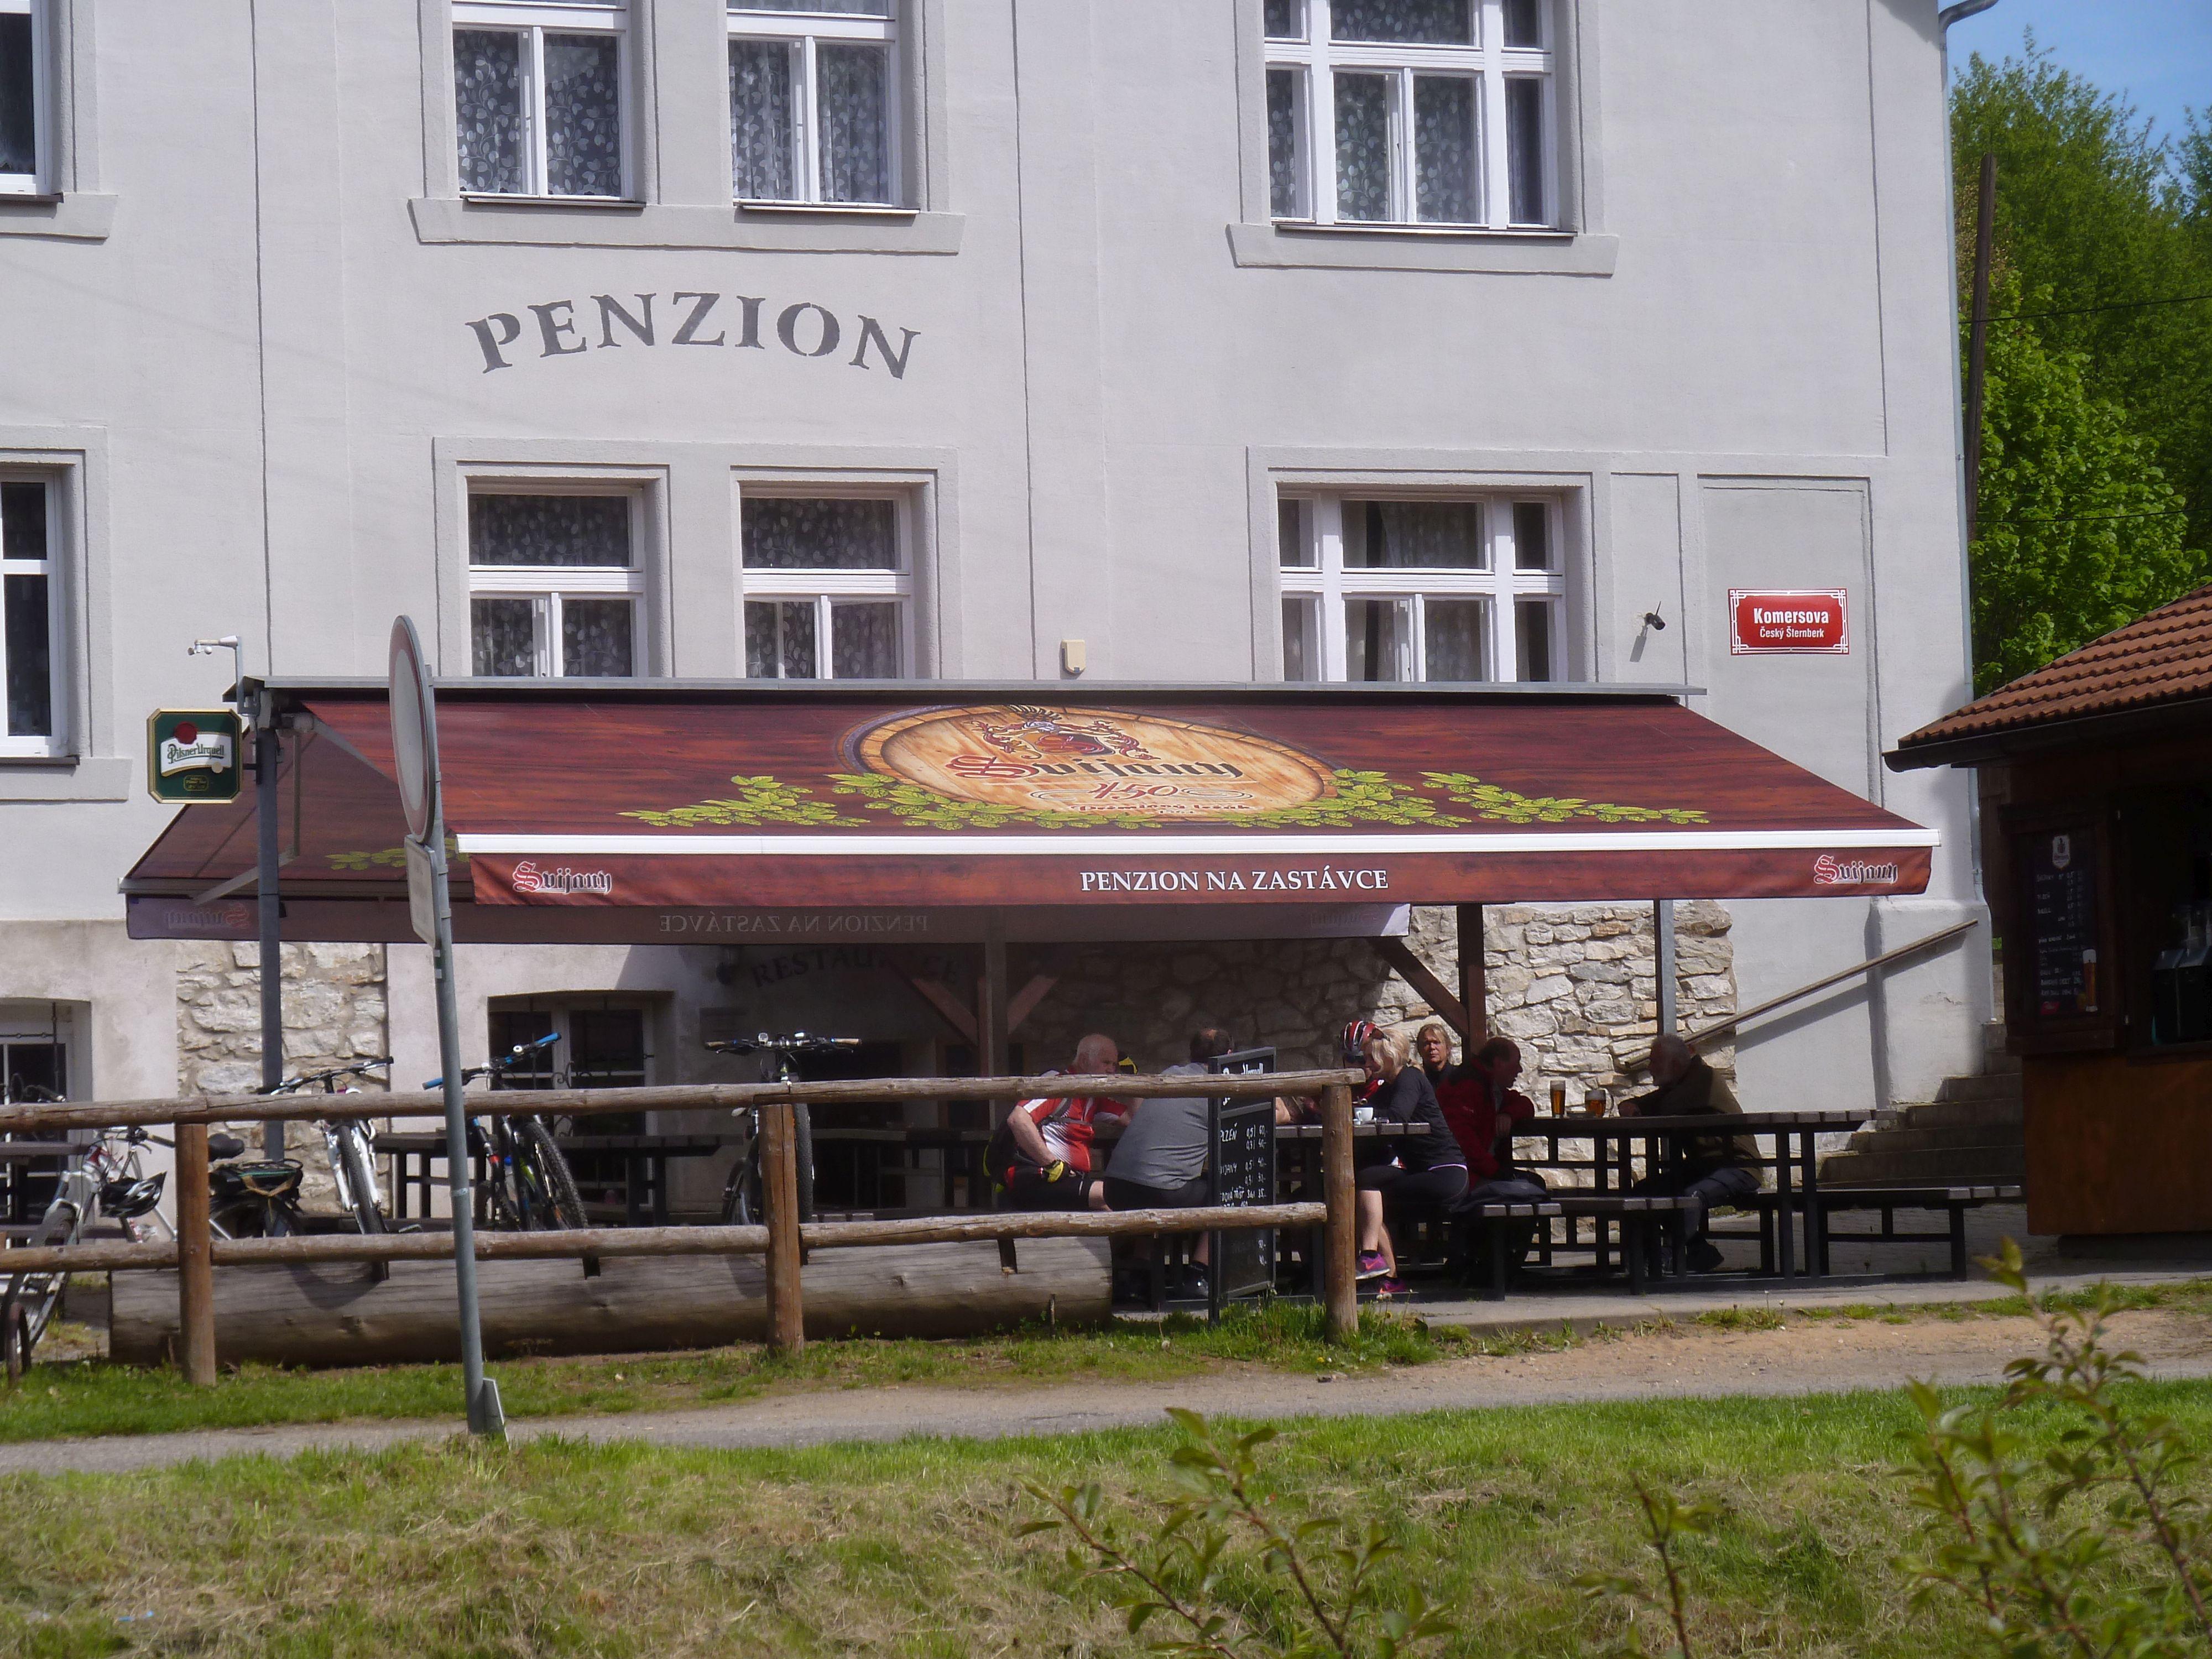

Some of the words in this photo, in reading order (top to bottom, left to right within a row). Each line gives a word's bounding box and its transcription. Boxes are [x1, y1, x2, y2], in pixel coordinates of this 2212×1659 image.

[465, 291, 921, 380] PENZION
[1753, 608, 1829, 624] Komersova
[1760, 626, 1785, 640] Český
[1786, 625, 1824, 638] Šternberk
[167, 743, 199, 764] Pilsner
[196, 742, 225, 759] Urquell
[945, 755, 1244, 779] Svijany
[1088, 781, 1179, 800] 450
[512, 860, 612, 895] Svijany
[1080, 870, 1199, 892] PENZION
[1206, 870, 1247, 891] NA
[1251, 865, 1389, 890] ZASTÁVCE
[1813, 854, 1898, 884] Svijany
